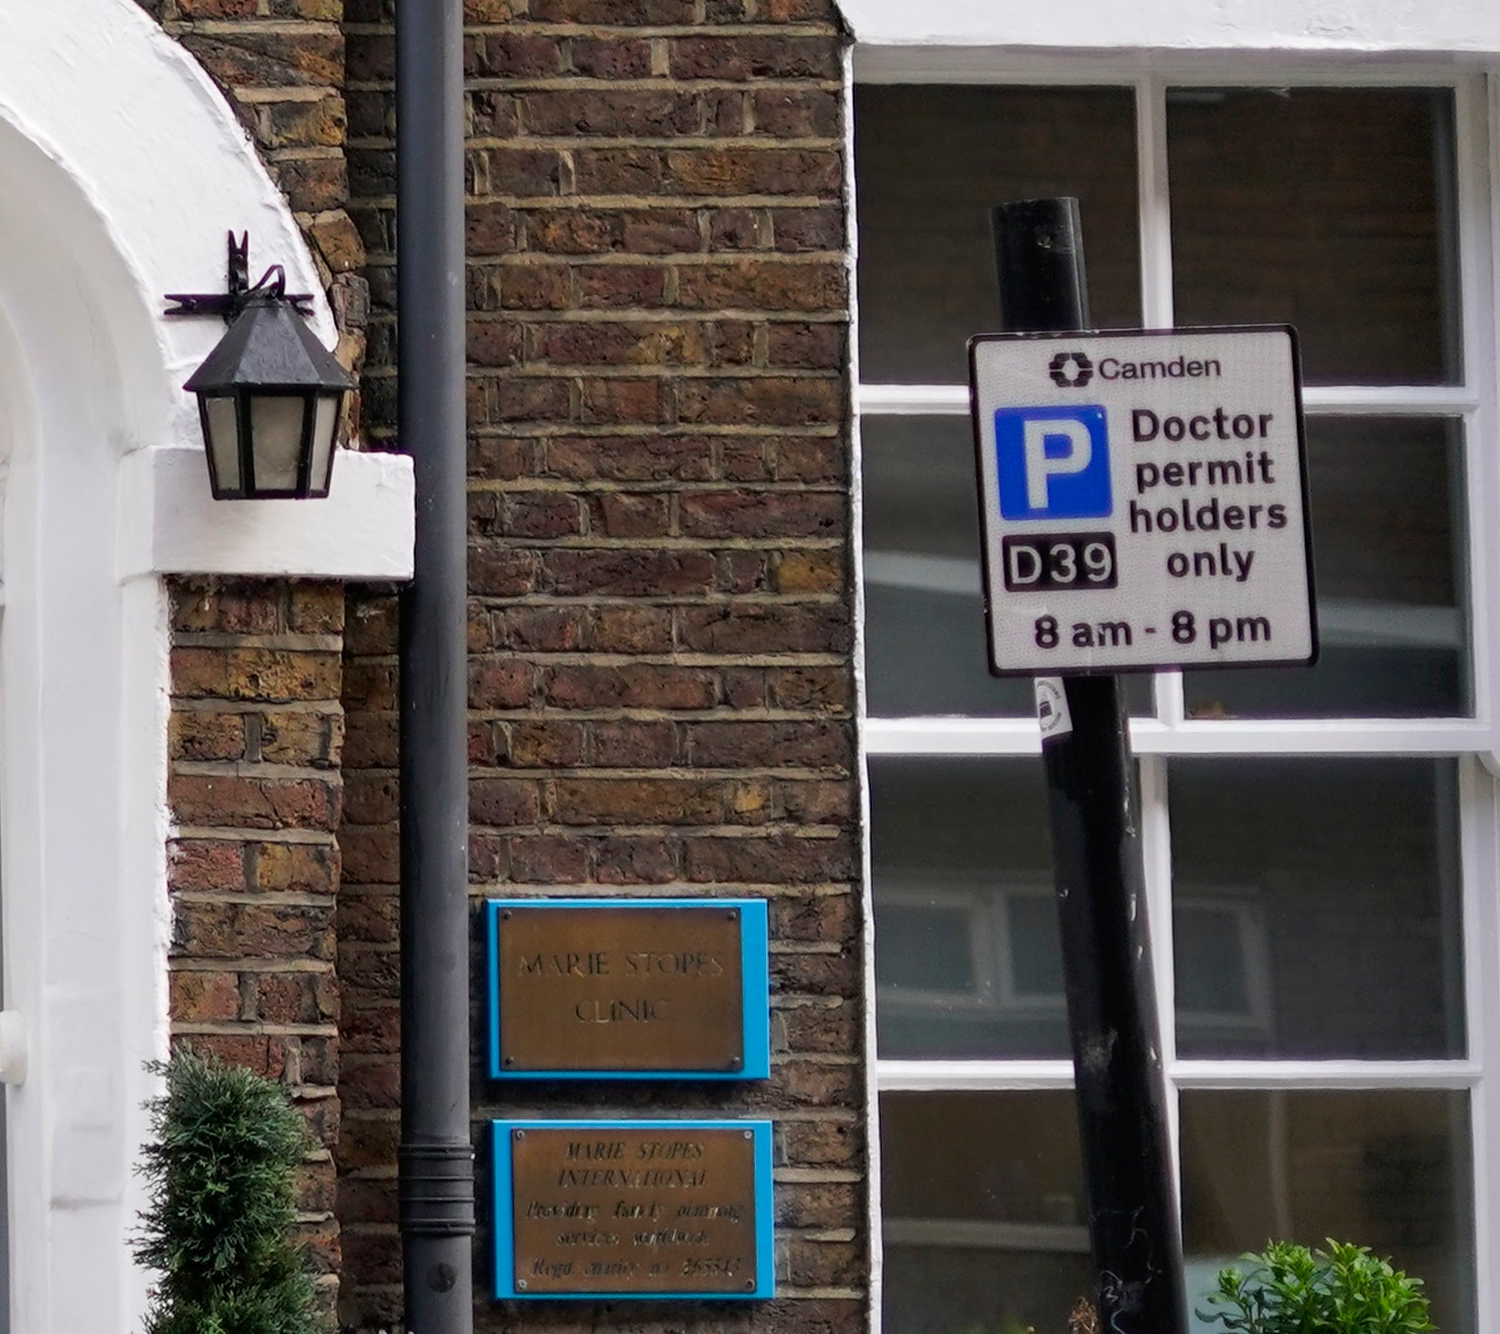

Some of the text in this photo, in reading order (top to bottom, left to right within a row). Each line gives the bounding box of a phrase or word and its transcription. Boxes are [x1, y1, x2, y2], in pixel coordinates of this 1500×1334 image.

[1099, 356, 1222, 381] Camden
[1130, 407, 1274, 443] Doctor
[1023, 419, 1093, 510] P
[1135, 451, 1276, 494] permit
[1129, 498, 1288, 533] holders
[1008, 543, 1113, 585] D39
[1166, 543, 1255, 583] only
[517, 952, 724, 978] MARIE STOPES
[575, 999, 668, 1023] CLINIC
[565, 1142, 704, 1161] MARIE STOPES
